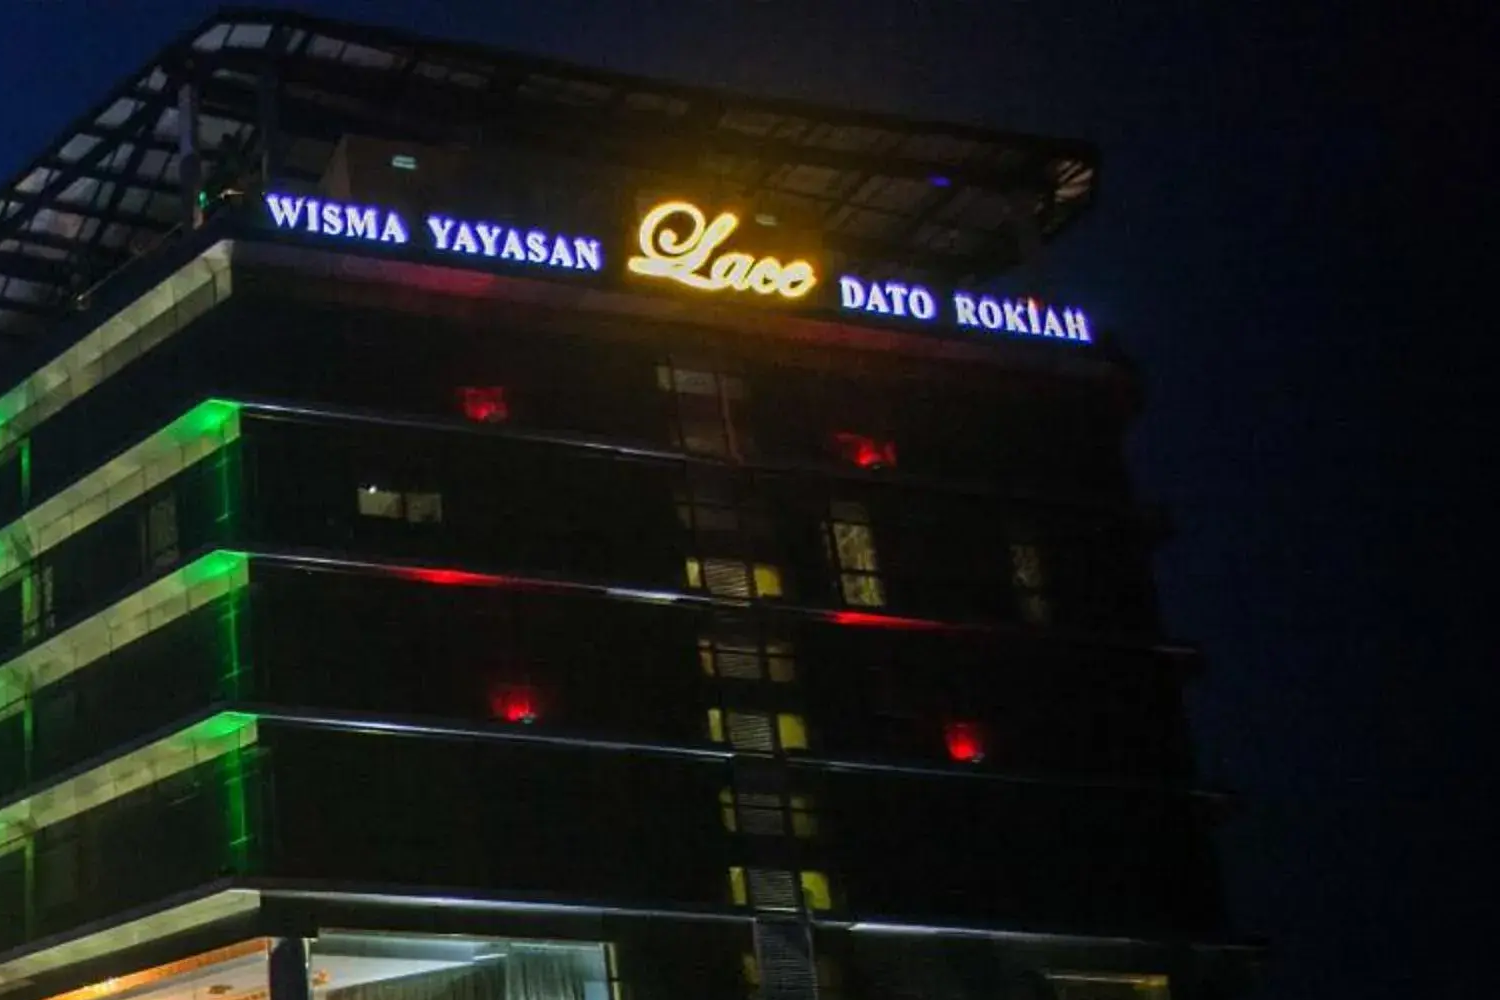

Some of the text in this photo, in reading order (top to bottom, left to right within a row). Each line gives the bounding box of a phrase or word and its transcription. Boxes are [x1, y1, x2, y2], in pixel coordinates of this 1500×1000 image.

[266, 193, 409, 244] WISMA
[428, 214, 601, 272] YAYASAN
[840, 275, 936, 321] DATO
[954, 292, 1092, 342] ROKIAH
